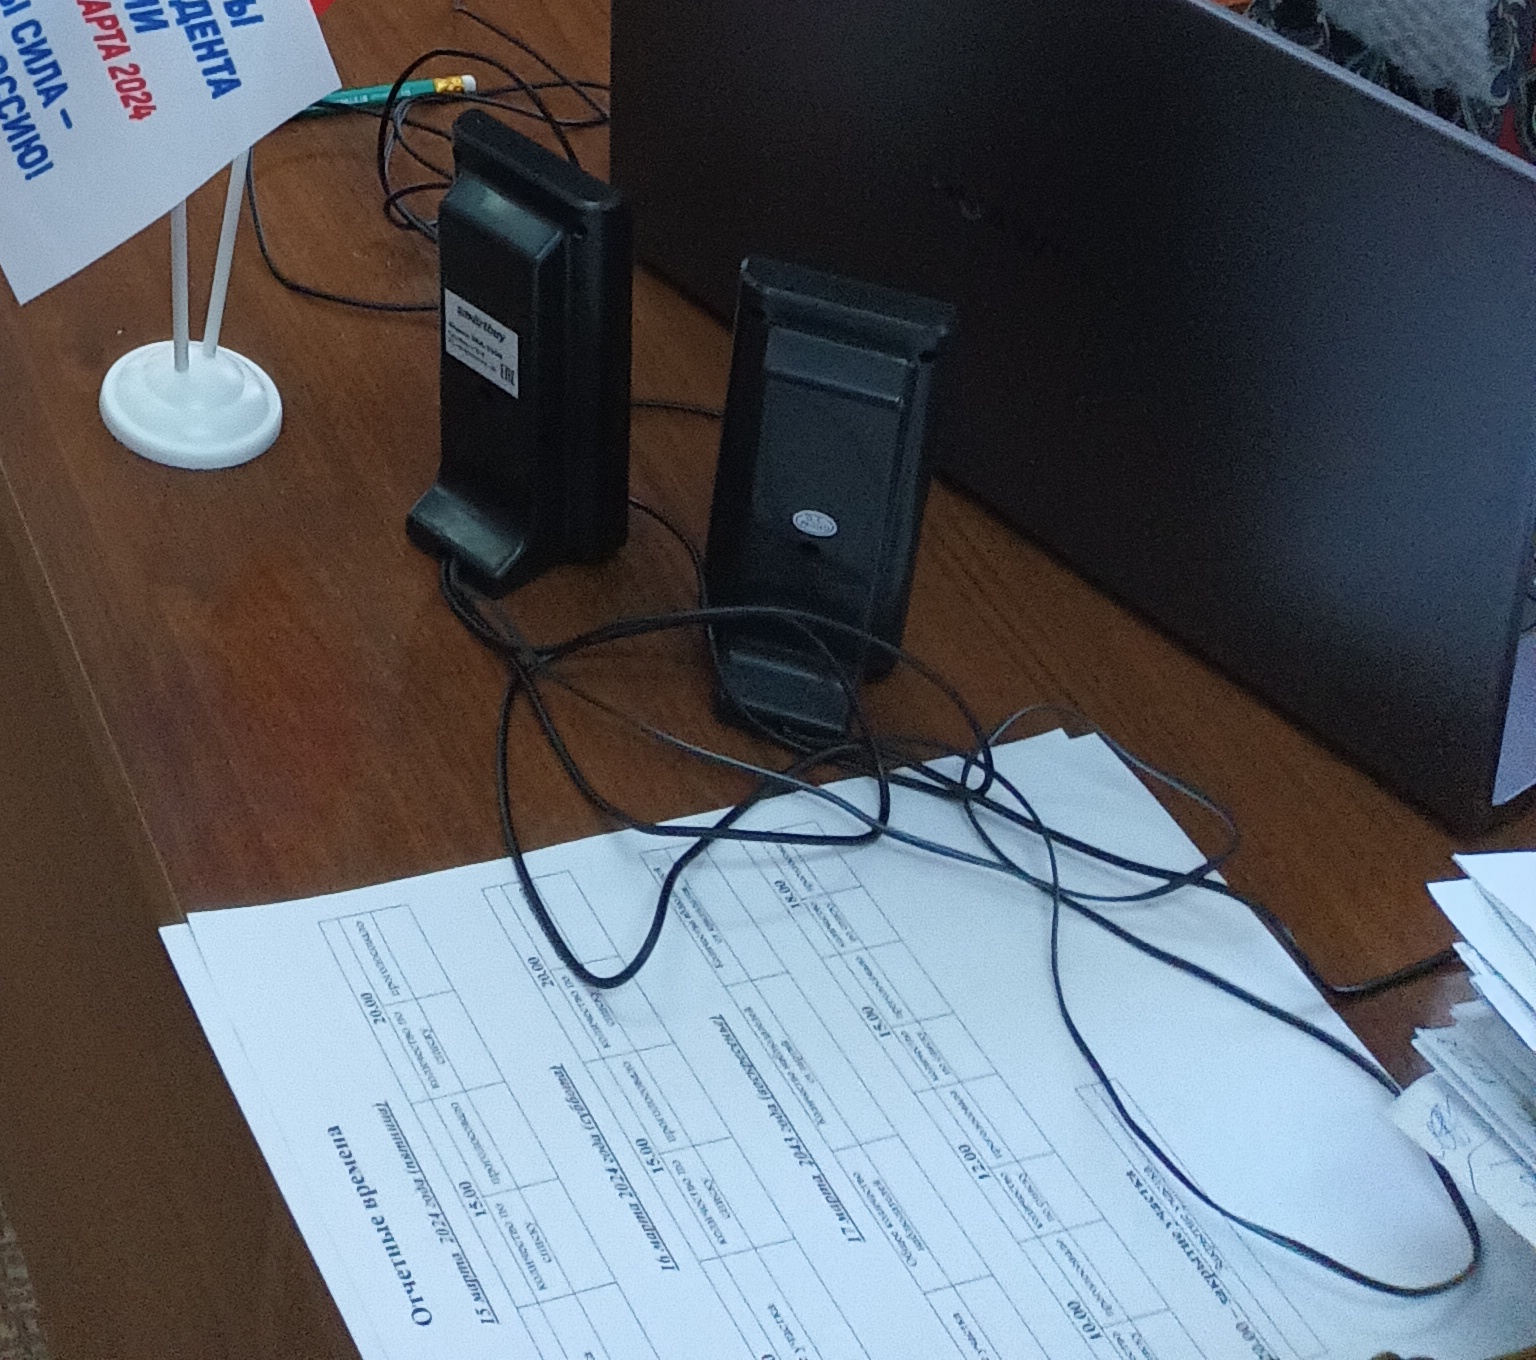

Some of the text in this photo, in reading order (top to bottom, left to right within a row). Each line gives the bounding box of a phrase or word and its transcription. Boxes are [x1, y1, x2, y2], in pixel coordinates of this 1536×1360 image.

[11, 18, 69, 110] СИЛА
[107, 62, 157, 122] 2024
[604, 1167, 634, 1200] 2024
[957, 1143, 992, 1180] 12.00
[327, 1124, 433, 1327] Отчетные времена
[628, 1197, 668, 1252] марта
[451, 1246, 489, 1303] марта
